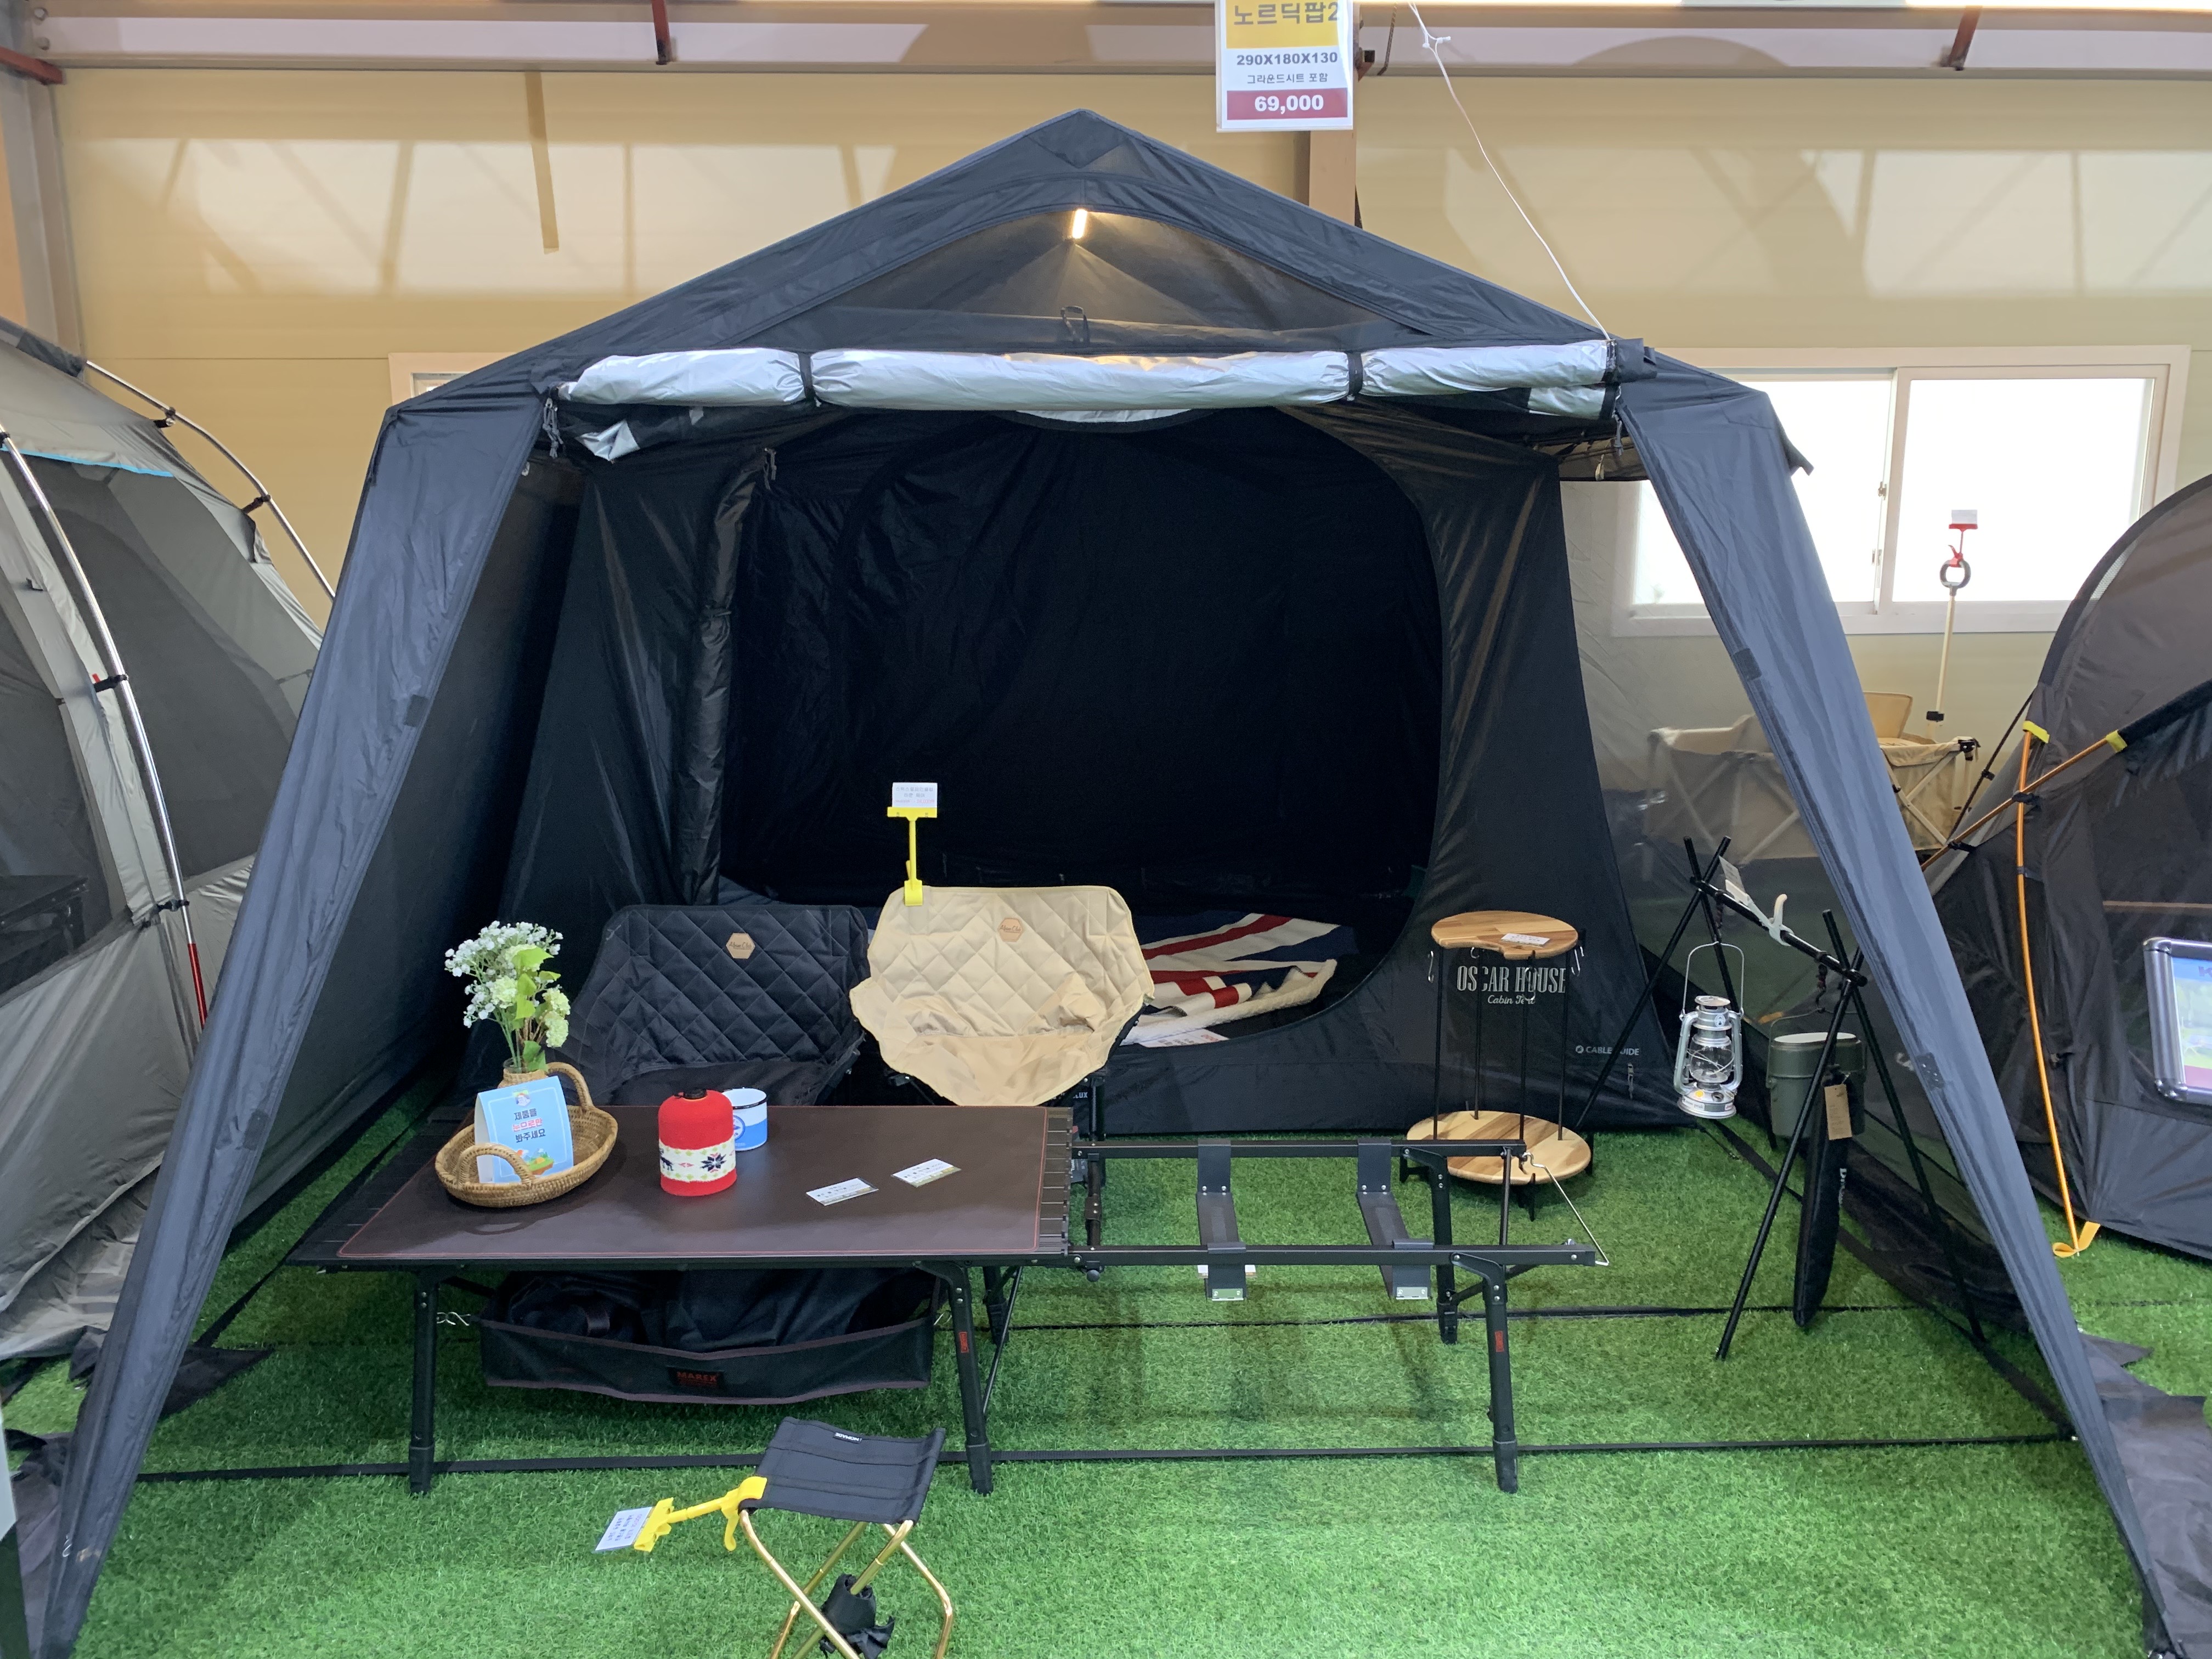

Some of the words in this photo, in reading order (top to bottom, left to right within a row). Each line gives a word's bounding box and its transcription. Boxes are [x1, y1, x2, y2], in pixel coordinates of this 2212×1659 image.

[1234, 2, 1340, 25] 노르딕팝2
[1237, 52, 1338, 65] 290X180X130
[1247, 74, 1305, 84] 그라운드시트
[1309, 72, 1328, 83] 포함
[1255, 94, 1324, 114] 69,000
[1515, 967, 1566, 994] HOUSE
[1487, 995, 1514, 1005] Cabin
[514, 1108, 537, 1121] 제품을
[512, 1118, 543, 1132] 눈으로만
[515, 1128, 546, 1143] 봐주세요
